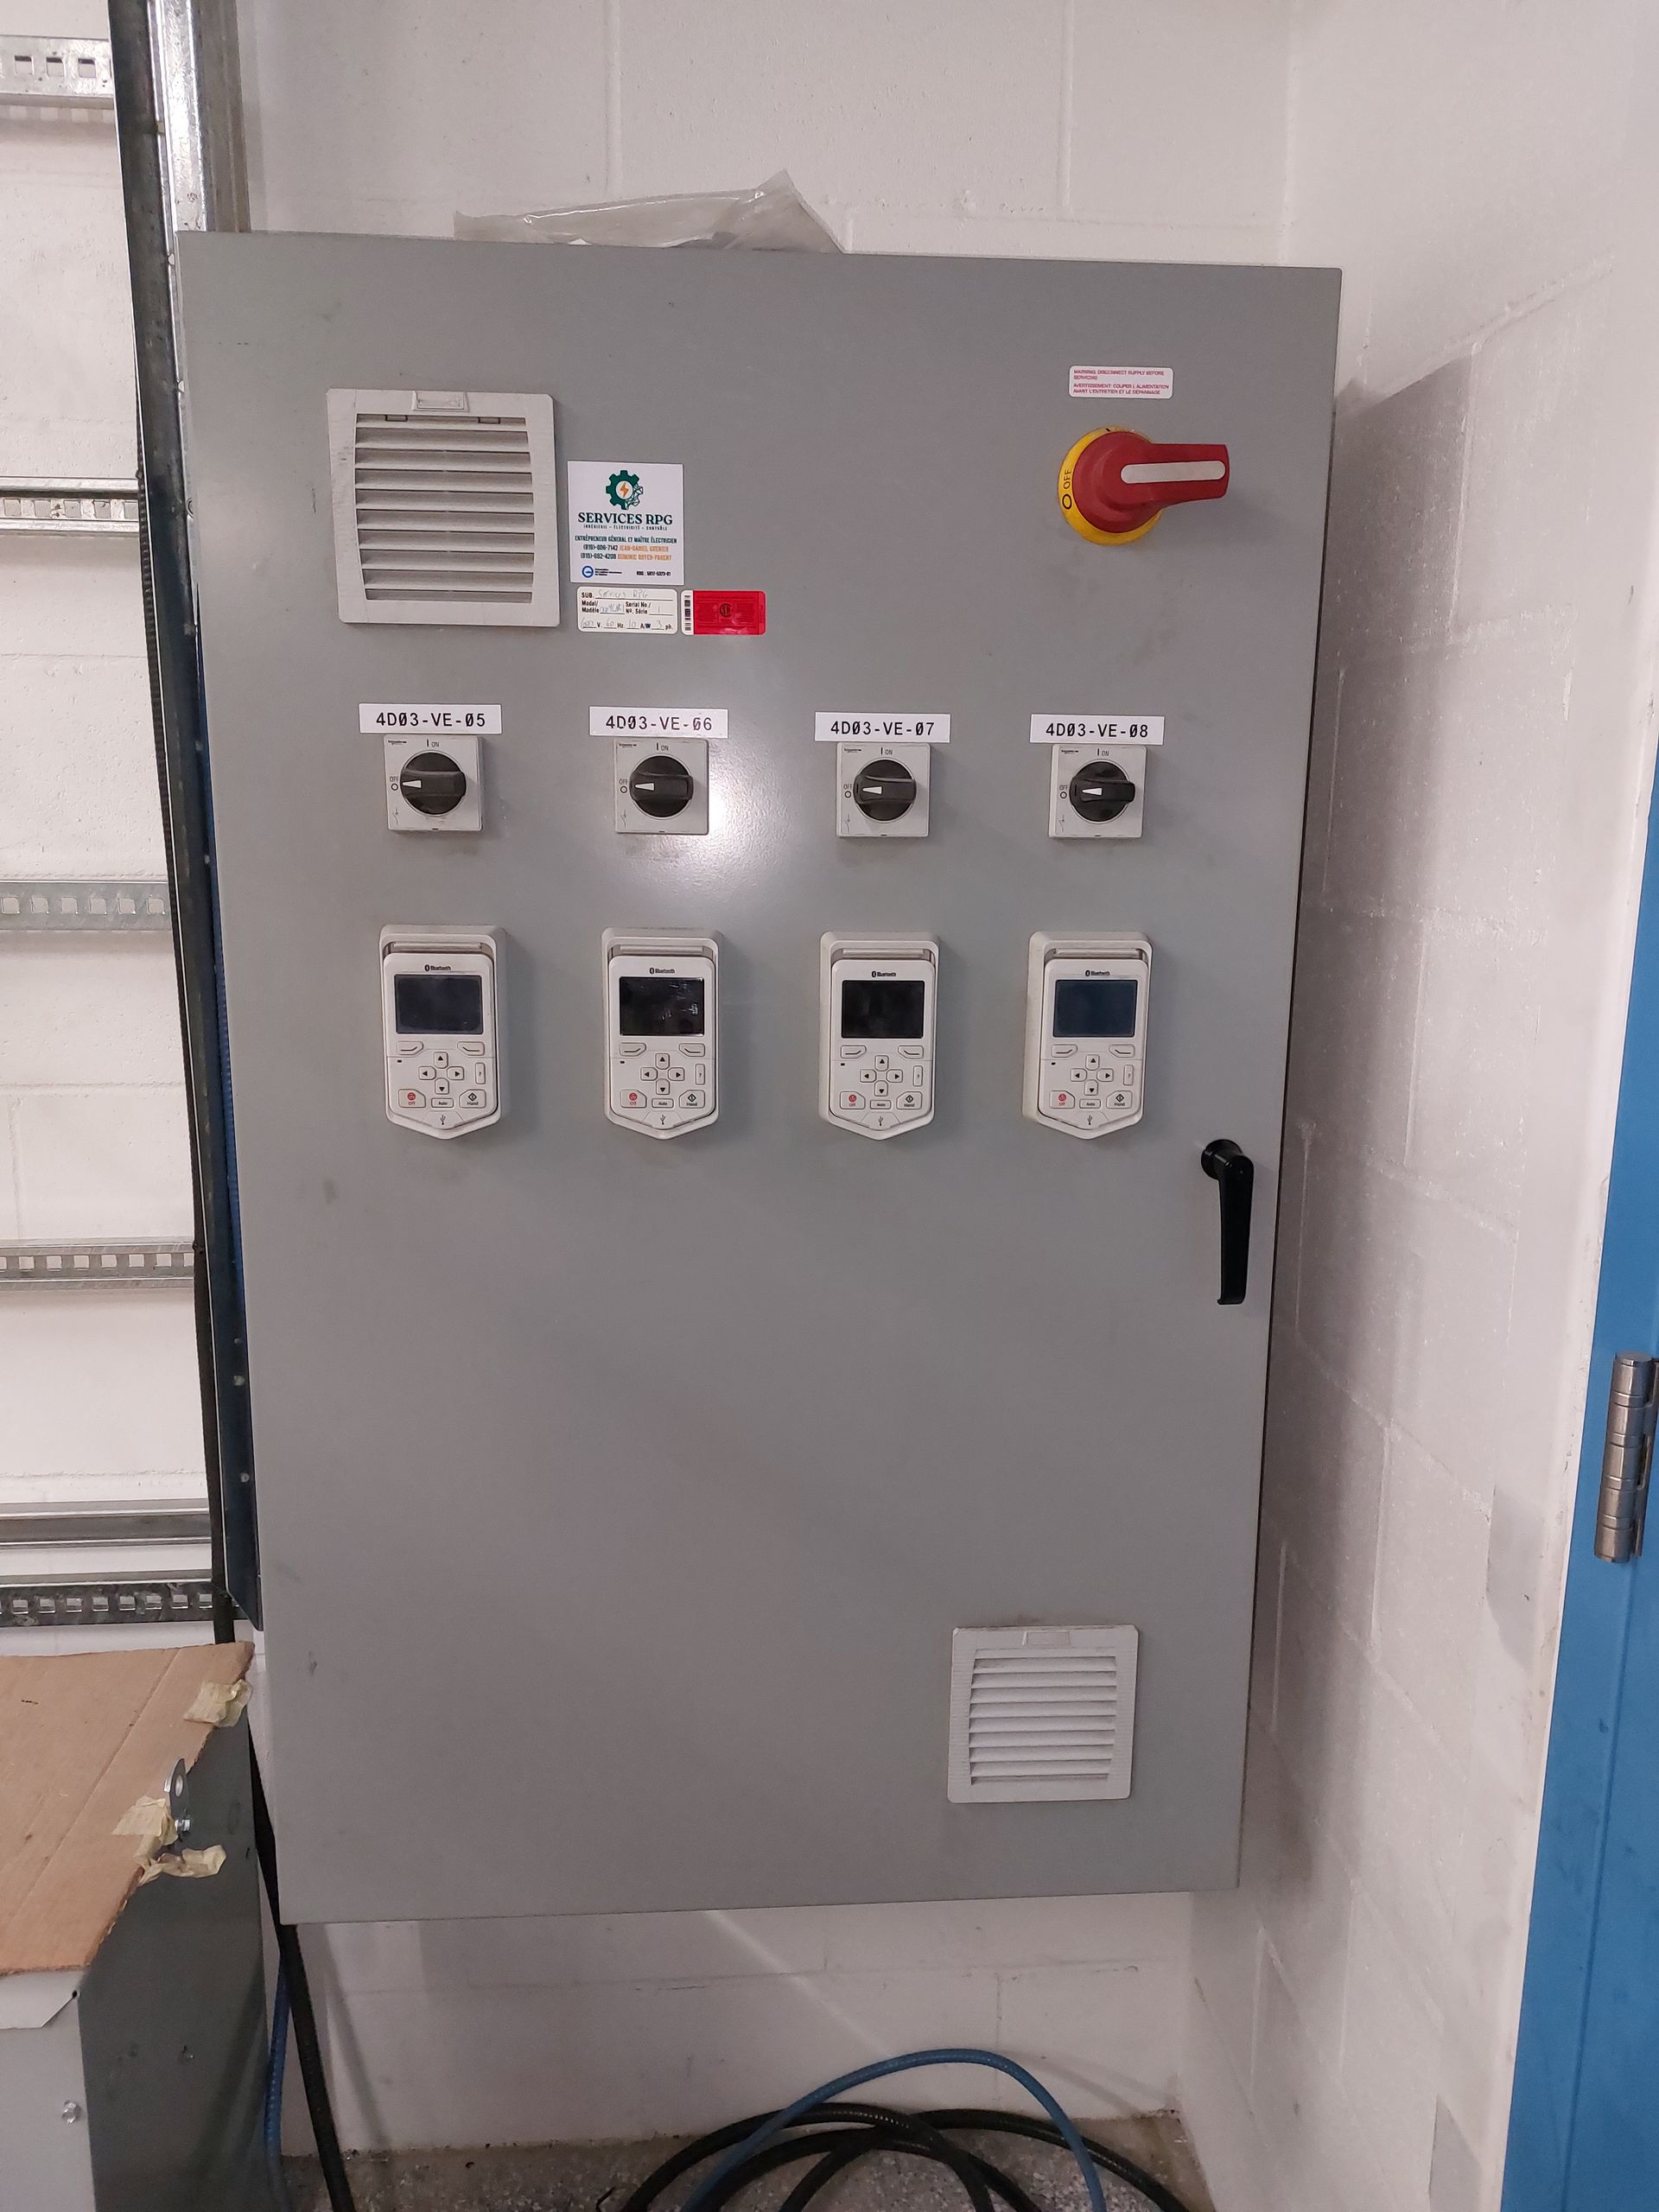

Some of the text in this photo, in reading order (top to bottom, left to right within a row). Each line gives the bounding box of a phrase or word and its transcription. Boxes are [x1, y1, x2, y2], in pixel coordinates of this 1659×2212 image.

[578, 512, 672, 525] SERVICES RPG
[376, 712, 485, 727] 4D03-VE-05
[606, 715, 712, 731] 4D03-VE-06
[831, 721, 934, 736] 4D03-VE-07
[1046, 723, 1148, 738] 4D03-VE-08
